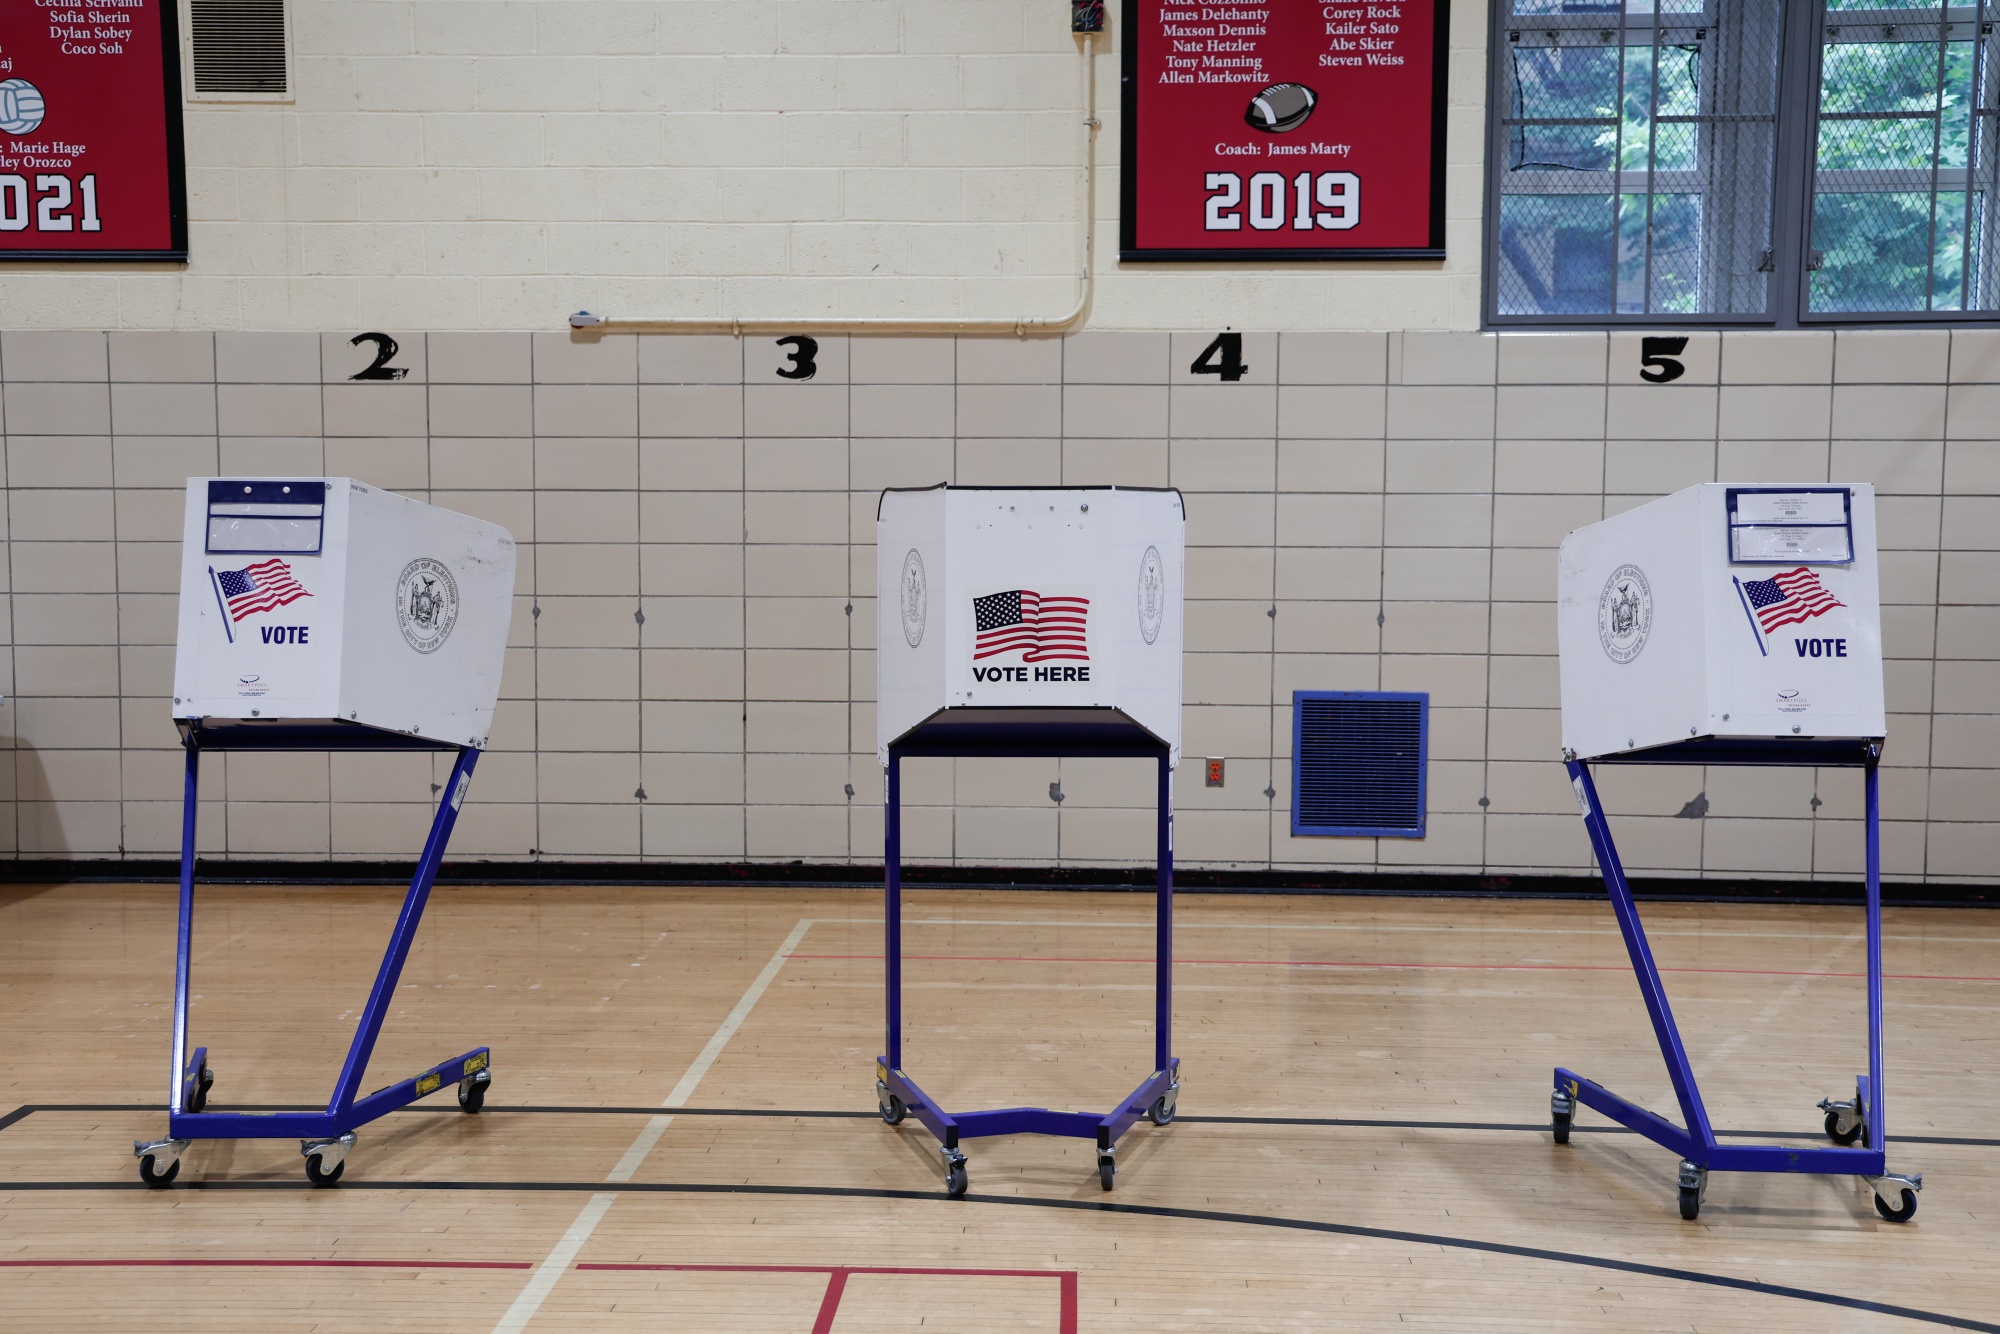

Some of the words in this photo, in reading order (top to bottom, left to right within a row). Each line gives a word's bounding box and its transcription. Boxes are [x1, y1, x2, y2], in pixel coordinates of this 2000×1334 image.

[50, 11, 85, 23] Sofia
[88, 11, 130, 23] Sherin
[1159, 9, 1198, 23] James
[1202, 8, 1270, 23] Delehanty
[1323, 7, 1364, 22] Corey
[1367, 5, 1401, 18] Rock
[49, 26, 91, 42] Dylan
[94, 26, 133, 42] Sobey
[1163, 25, 1215, 36] Maxson
[1219, 24, 1266, 35] Dennis
[1325, 22, 1367, 34] Kailer
[1370, 22, 1399, 34] Sato
[61, 42, 96, 54] Coco
[99, 42, 123, 54] Soh
[1173, 40, 1203, 52] Nate
[1207, 39, 1256, 52] Hetzler
[1329, 38, 1356, 50] Abe
[1359, 37, 1395, 50] Skier
[1166, 56, 1199, 71] Tony
[1202, 55, 1263, 70] Manning
[1319, 54, 1362, 66] Steven
[1366, 53, 1404, 65] Weiss
[1158, 71, 1194, 83] Allen
[1198, 70, 1270, 83] Markowitz
[10, 142, 49, 154] Marie
[52, 142, 86, 157] Hage
[1215, 142, 1261, 155] Coach:
[1267, 142, 1307, 157] James
[1310, 142, 1351, 158] Marty
[23, 156, 72, 168] Orozco
[1205, 170, 1362, 231] 2019
[347, 332, 409, 381] 2
[776, 334, 818, 382] 3
[1191, 332, 1248, 381] 4
[1639, 336, 1689, 383] 5
[261, 625, 309, 644] VOTE
[1794, 638, 1847, 658] VOTE
[972, 667, 1028, 683] VOTE
[1034, 666, 1090, 682] HERE
